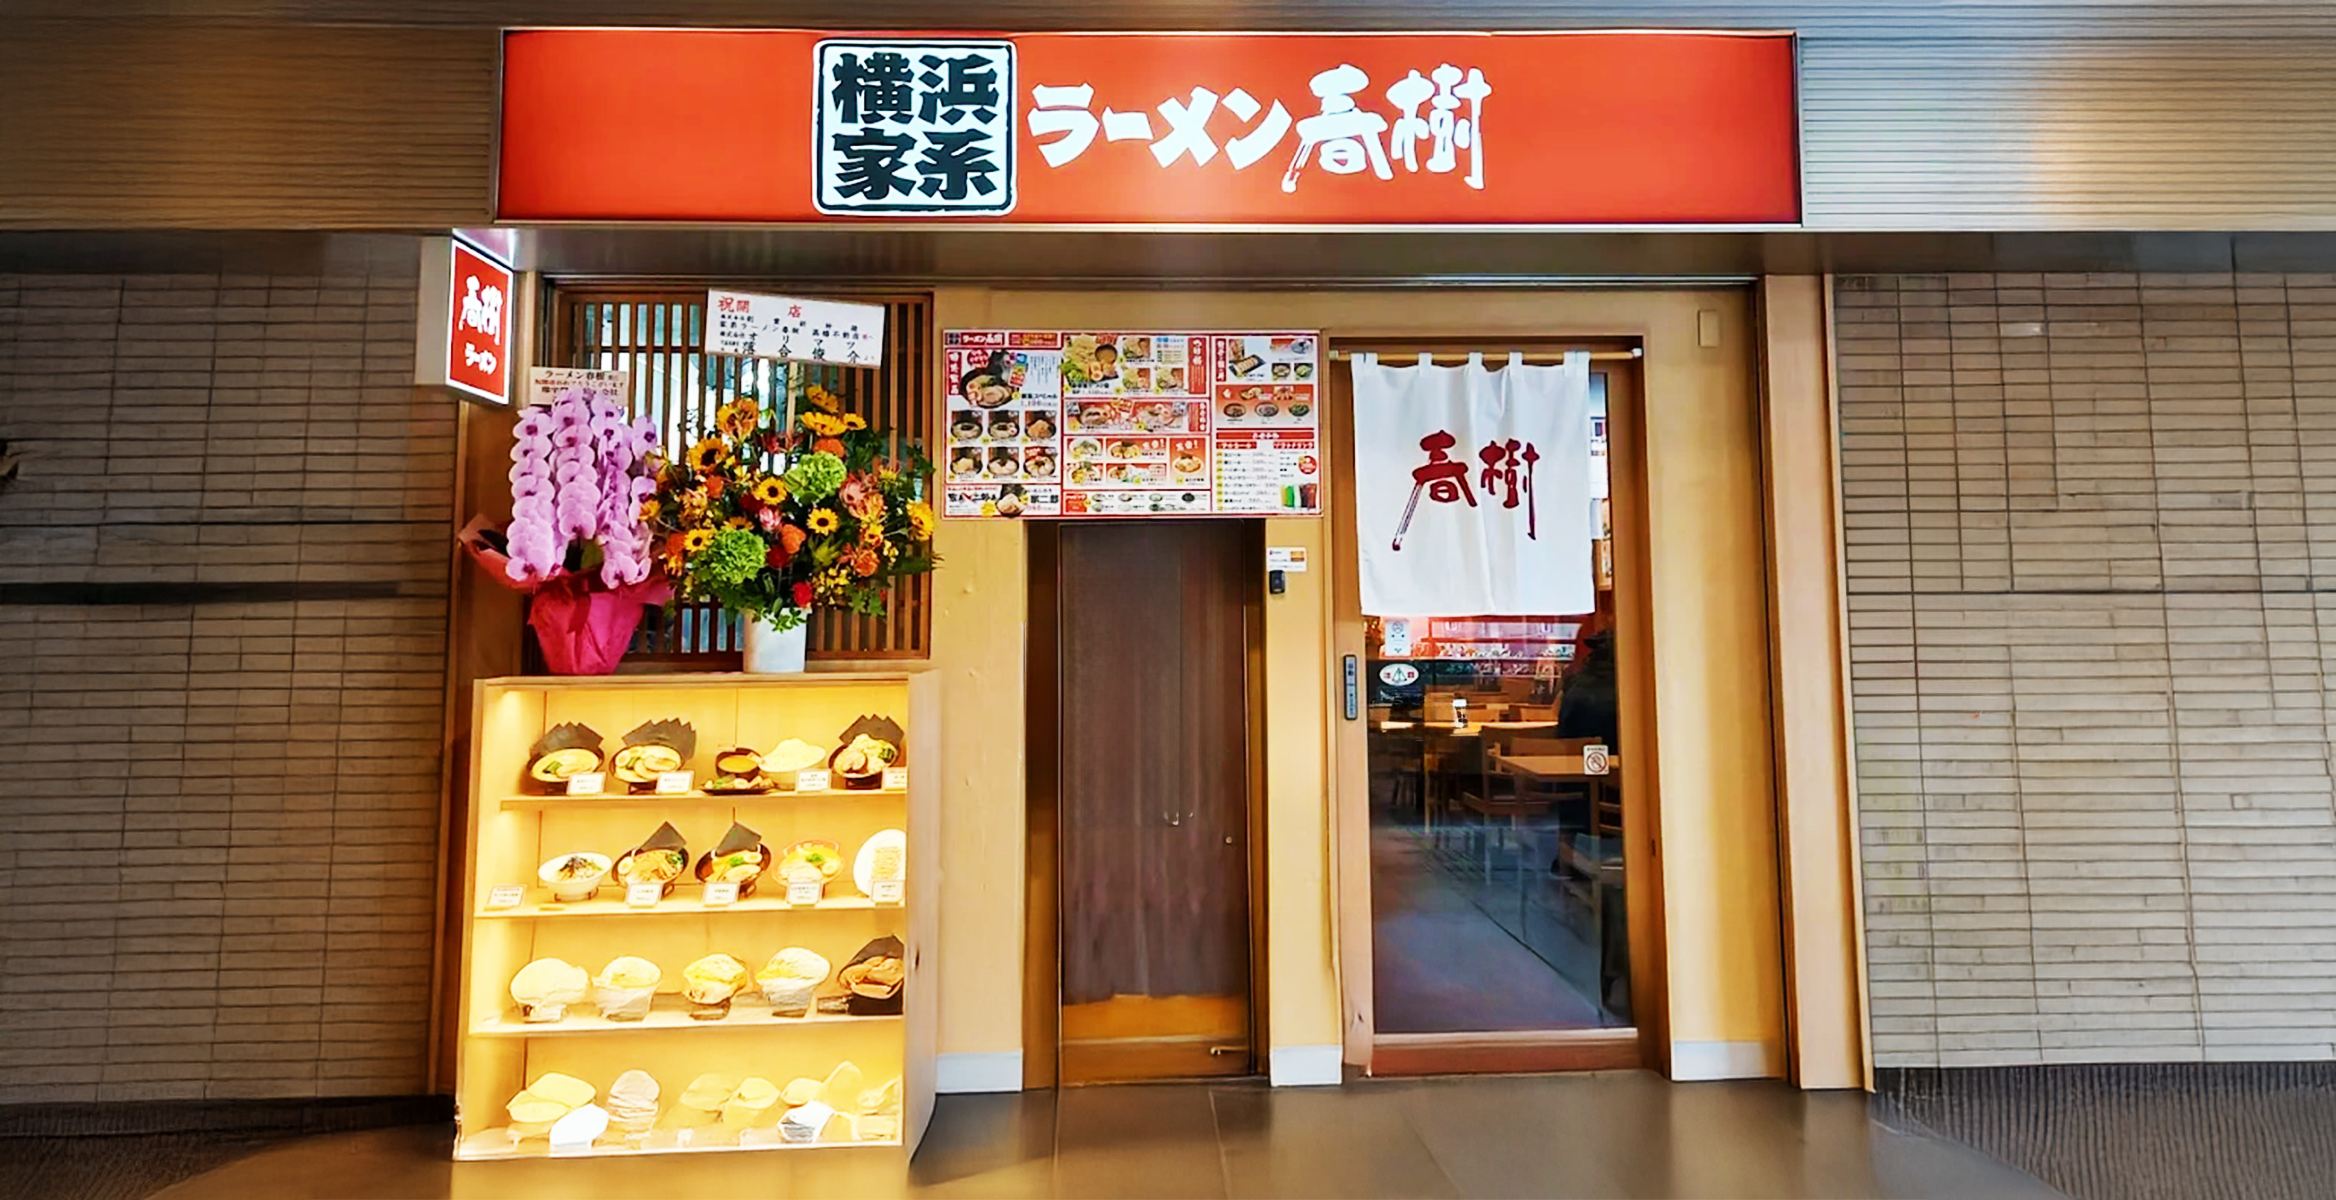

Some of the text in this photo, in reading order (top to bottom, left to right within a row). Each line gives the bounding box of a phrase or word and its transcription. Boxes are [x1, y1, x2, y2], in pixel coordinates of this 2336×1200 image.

[832, 52, 999, 125] 横浜
[831, 127, 1000, 200] 家系
[458, 275, 503, 345] 春樹
[464, 342, 497, 375] ラーメン
[1391, 429, 1540, 551] 春樹
